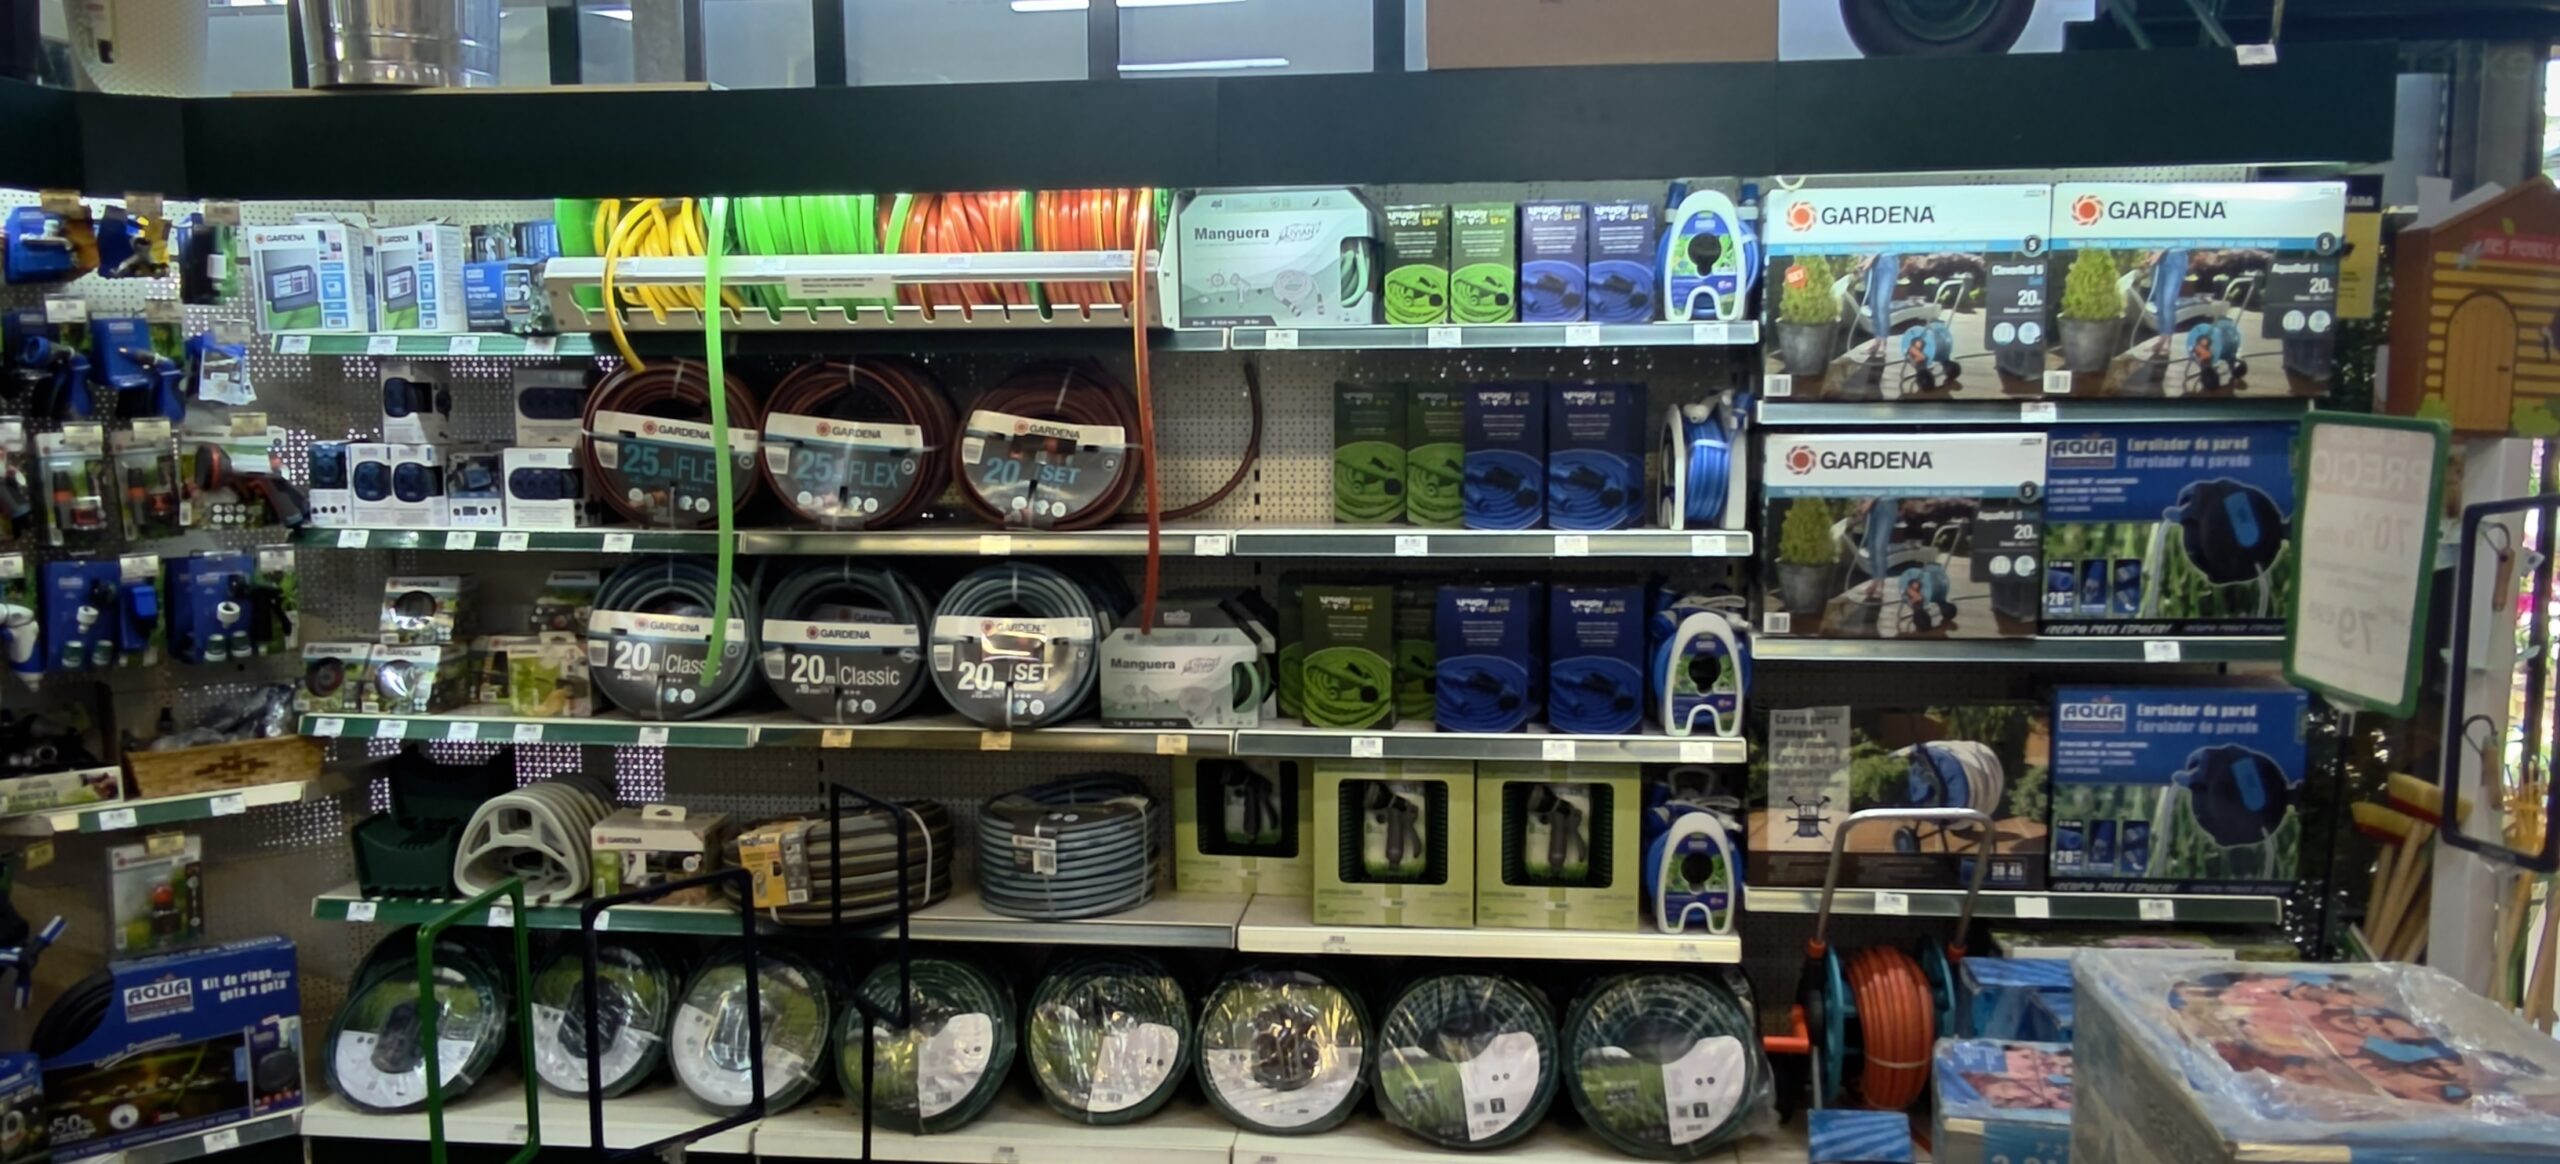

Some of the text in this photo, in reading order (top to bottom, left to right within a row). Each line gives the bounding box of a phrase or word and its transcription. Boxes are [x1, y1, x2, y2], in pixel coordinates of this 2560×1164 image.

[1821, 206, 1935, 225] GARDENA
[2108, 200, 2226, 220] GARDENA
[1194, 228, 1270, 242] Manguera
[659, 425, 711, 440] GARDENA
[832, 426, 882, 439] GARDENA
[1030, 424, 1080, 439] GARDENA
[2053, 440, 2114, 455] AQUA
[1820, 451, 1934, 470] GARDENA
[678, 455, 716, 484] FLE
[850, 460, 899, 488] FLEX
[1040, 464, 1081, 484] SET
[650, 621, 700, 632] GARDENA
[820, 629, 871, 640] GARDENA
[1014, 663, 1054, 681] SET
[1110, 657, 1176, 672] Manguera
[840, 665, 900, 686] Classic
[2064, 704, 2124, 719] AQUA
[2203, 703, 2218, 717] de
[2221, 703, 2257, 718] pared
[201, 977, 219, 991] Kit
[219, 988, 246, 1003] gota
[260, 979, 287, 995] gota
[128, 980, 189, 1004] AQUA
